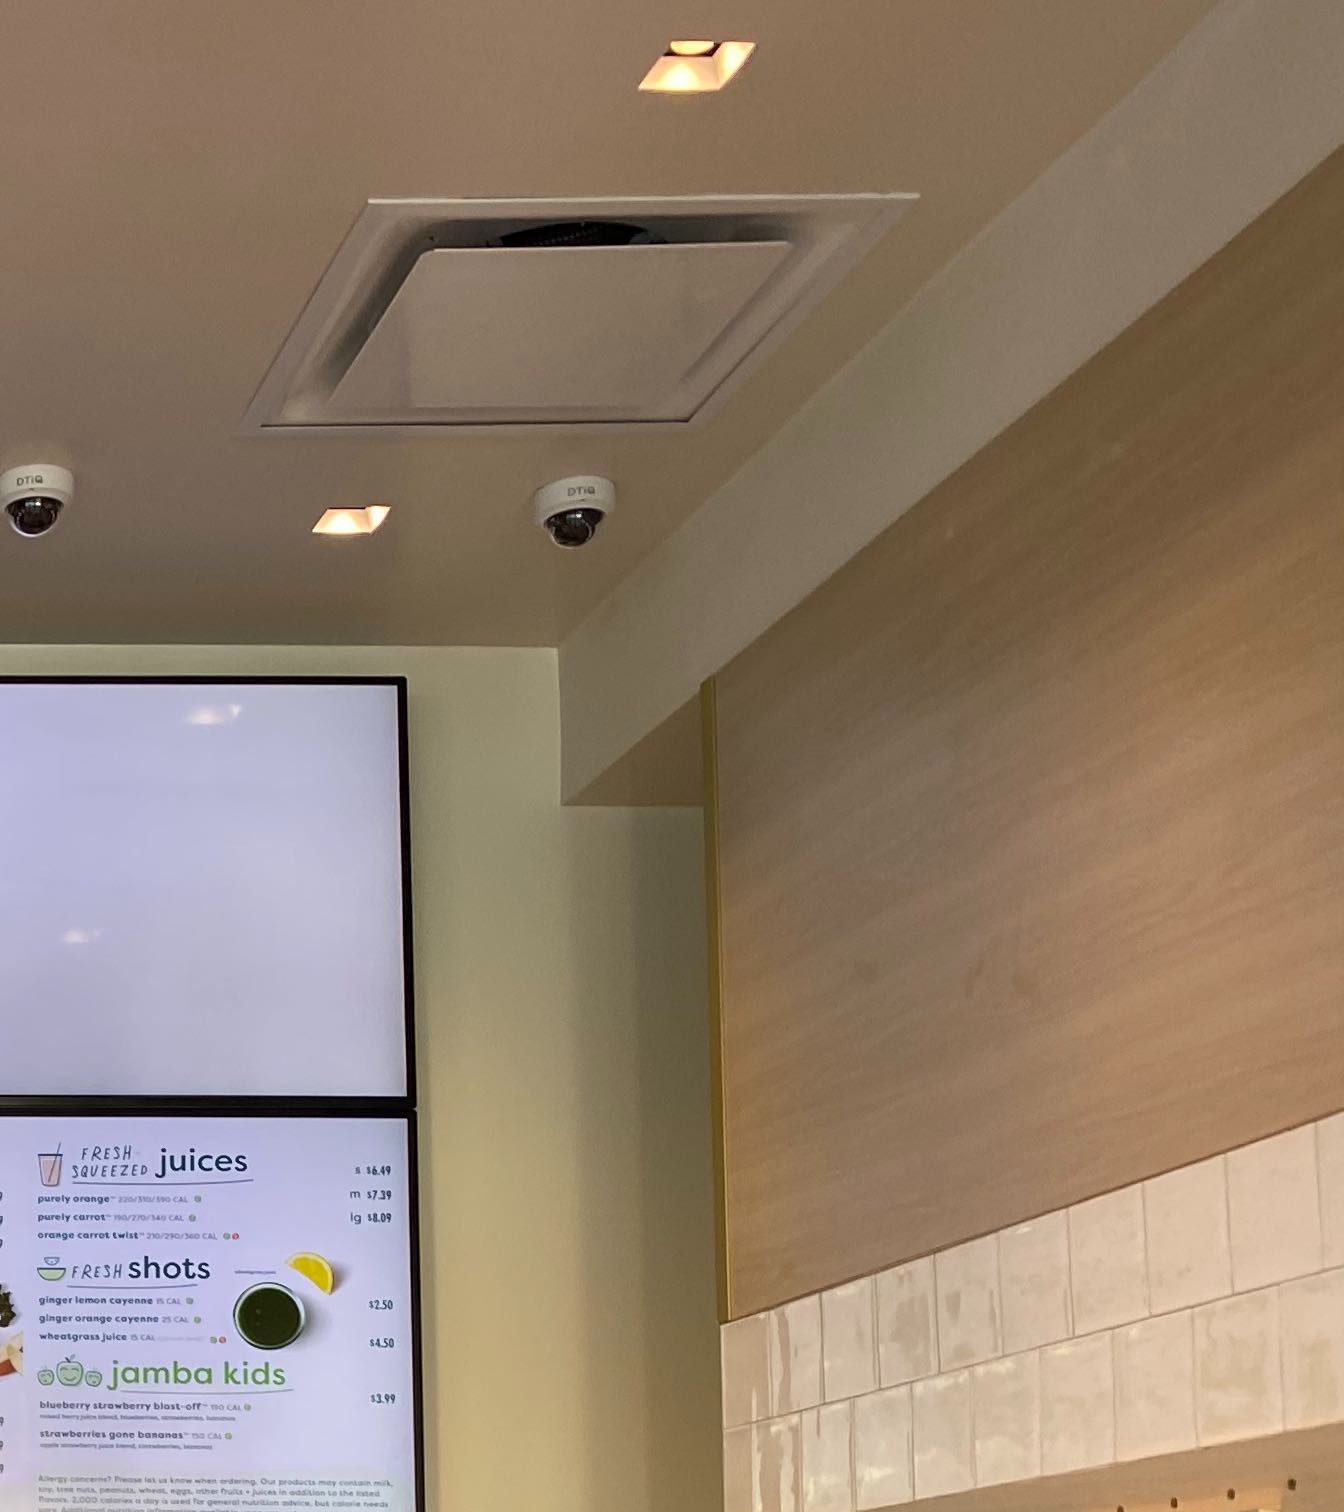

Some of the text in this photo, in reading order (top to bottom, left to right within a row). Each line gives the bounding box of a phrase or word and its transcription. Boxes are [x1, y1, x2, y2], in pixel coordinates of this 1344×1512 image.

[71, 1148, 248, 1179] SQUEEZED juices
[366, 1165, 391, 1176] $6.49
[349, 1189, 392, 1201] m $7.39
[367, 1212, 392, 1224] $8.09
[71, 1255, 211, 1280] FRESH shots
[39, 1296, 153, 1306] ginger lemon cayenne
[368, 1299, 394, 1310] $2.50
[39, 1314, 159, 1324] ginger orange cayenne
[39, 1333, 127, 1342] wheatgrass juice
[369, 1338, 395, 1348] $4.50
[107, 1360, 286, 1391] jamba kids
[370, 1393, 396, 1404] $3.99
[39, 1400, 90, 1410] blueberry
[93, 1401, 151, 1411] strawberry
